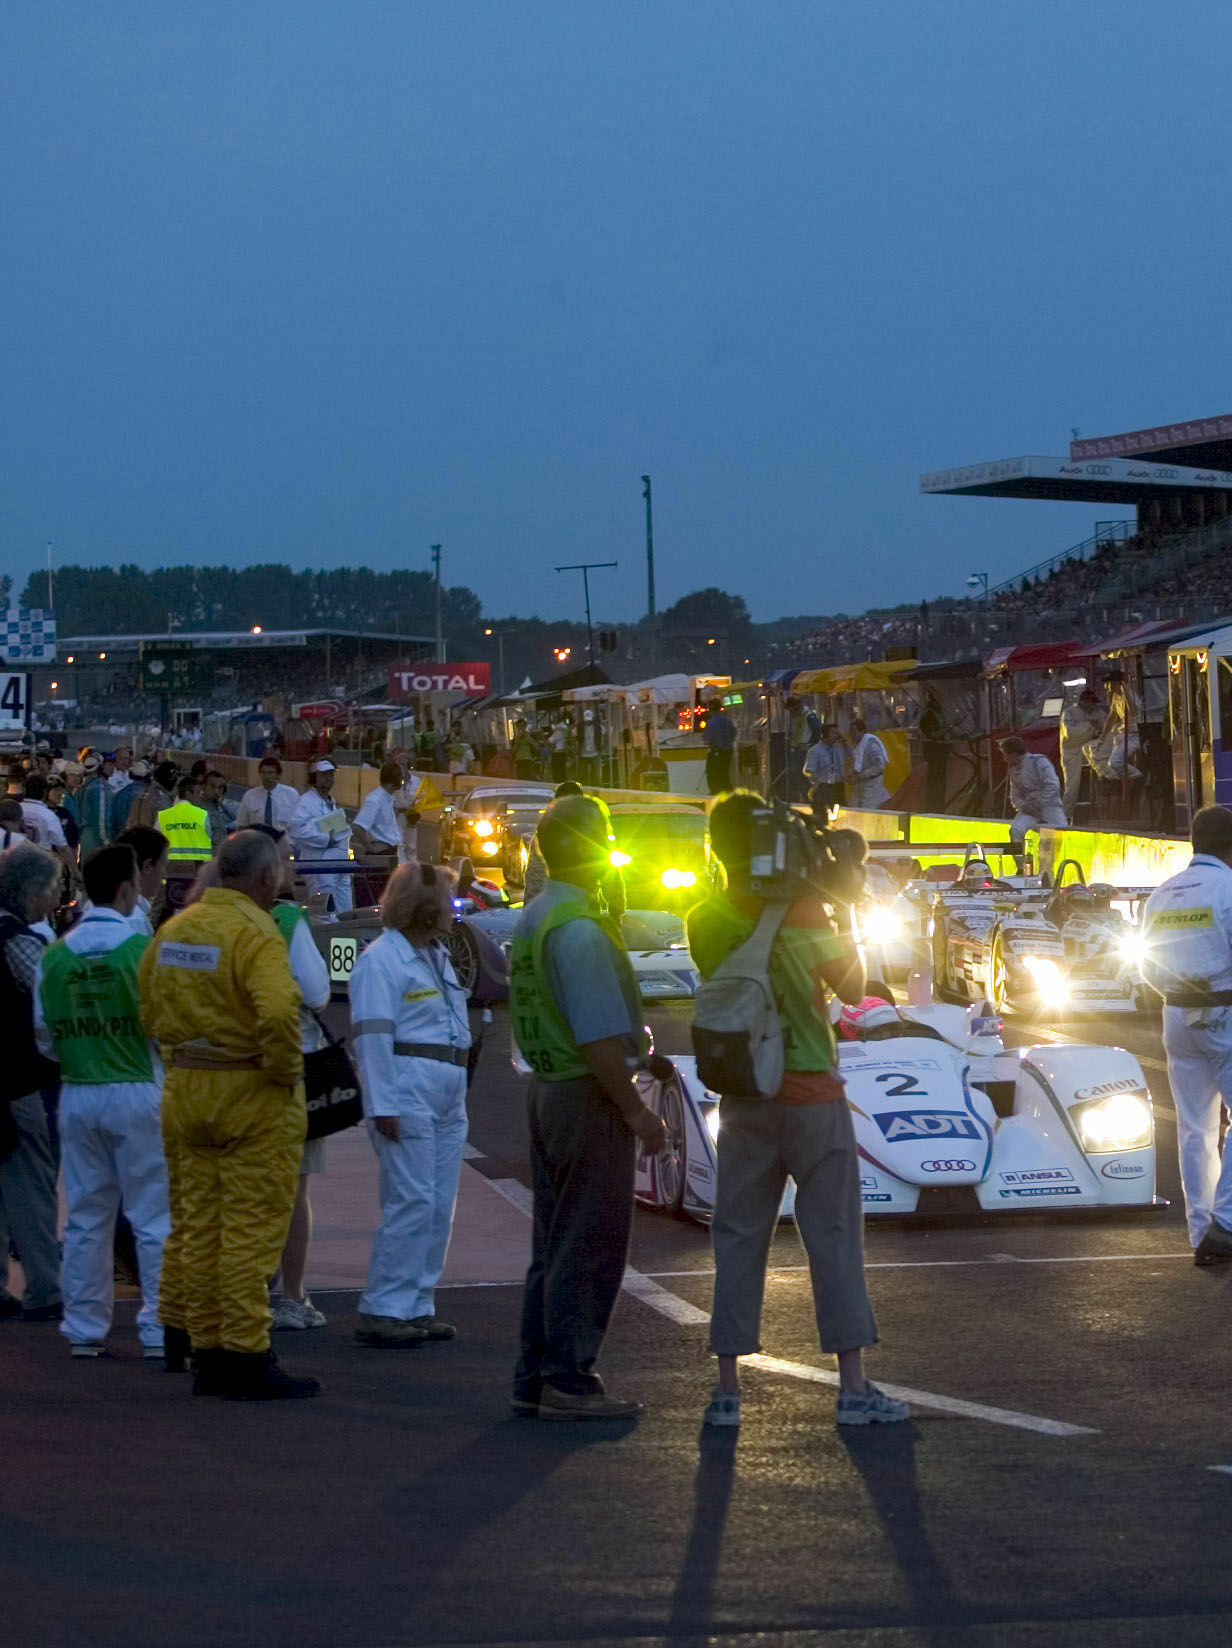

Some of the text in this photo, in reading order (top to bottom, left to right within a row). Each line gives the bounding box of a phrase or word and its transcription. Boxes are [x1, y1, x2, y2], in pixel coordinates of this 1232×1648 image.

[1059, 466, 1083, 474] Audi
[394, 672, 486, 691] TOTAL
[1, 676, 25, 719] 4
[165, 822, 197, 831] CONTROLE
[1155, 912, 1209, 924] DUNLOP
[332, 945, 354, 973] 88
[875, 1073, 929, 1097] 2
[1074, 1079, 1140, 1100] Canon
[886, 1114, 971, 1138] ADT
[1020, 1170, 1068, 1182] ANSUL
[1019, 1186, 1077, 1196] MICHELIN
